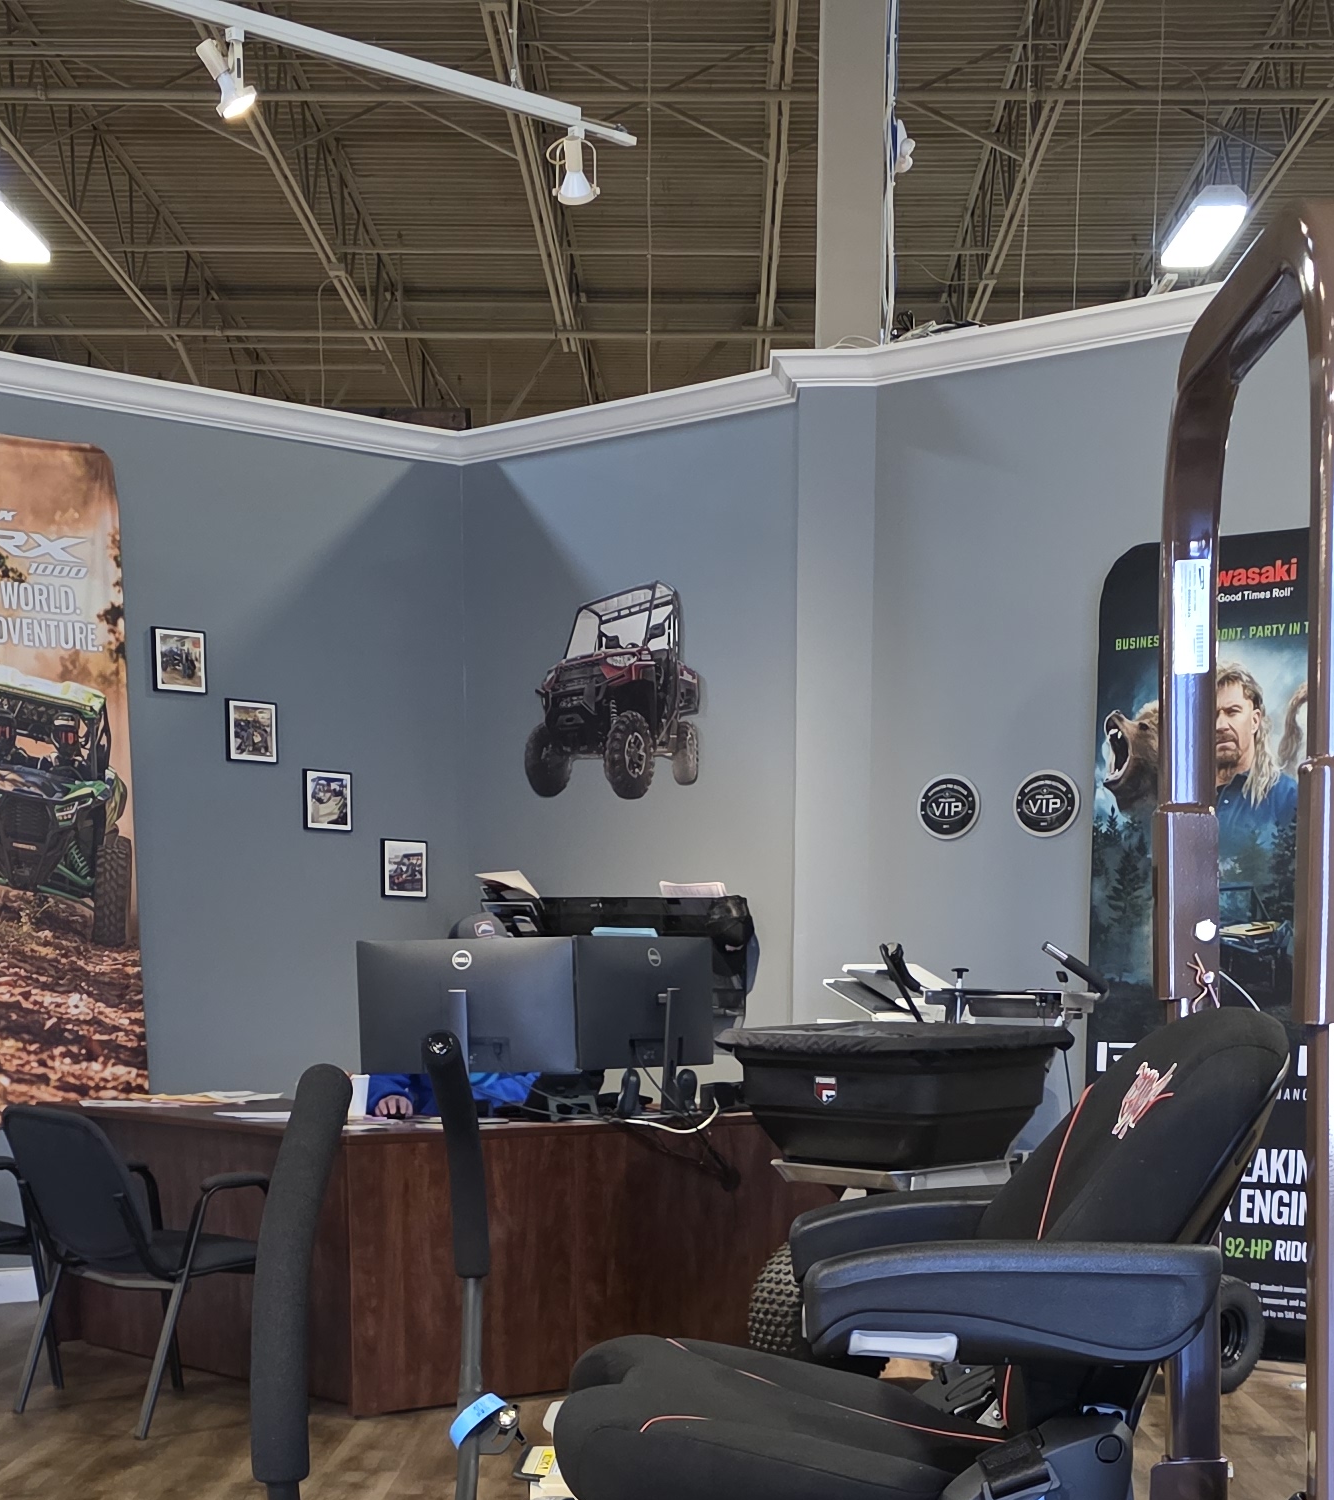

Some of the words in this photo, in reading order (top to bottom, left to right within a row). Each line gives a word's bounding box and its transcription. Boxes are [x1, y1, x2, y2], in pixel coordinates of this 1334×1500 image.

[27, 562, 88, 579] 1000
[0, 581, 81, 615] WORLD.
[1218, 592, 1242, 602] Good
[1243, 590, 1270, 600] Times
[1249, 624, 1286, 638] PARTY
[1288, 622, 1300, 635] IN
[932, 802, 962, 816] VIP
[1029, 799, 1060, 814] VIP
[1225, 1237, 1272, 1259] 92-HP
